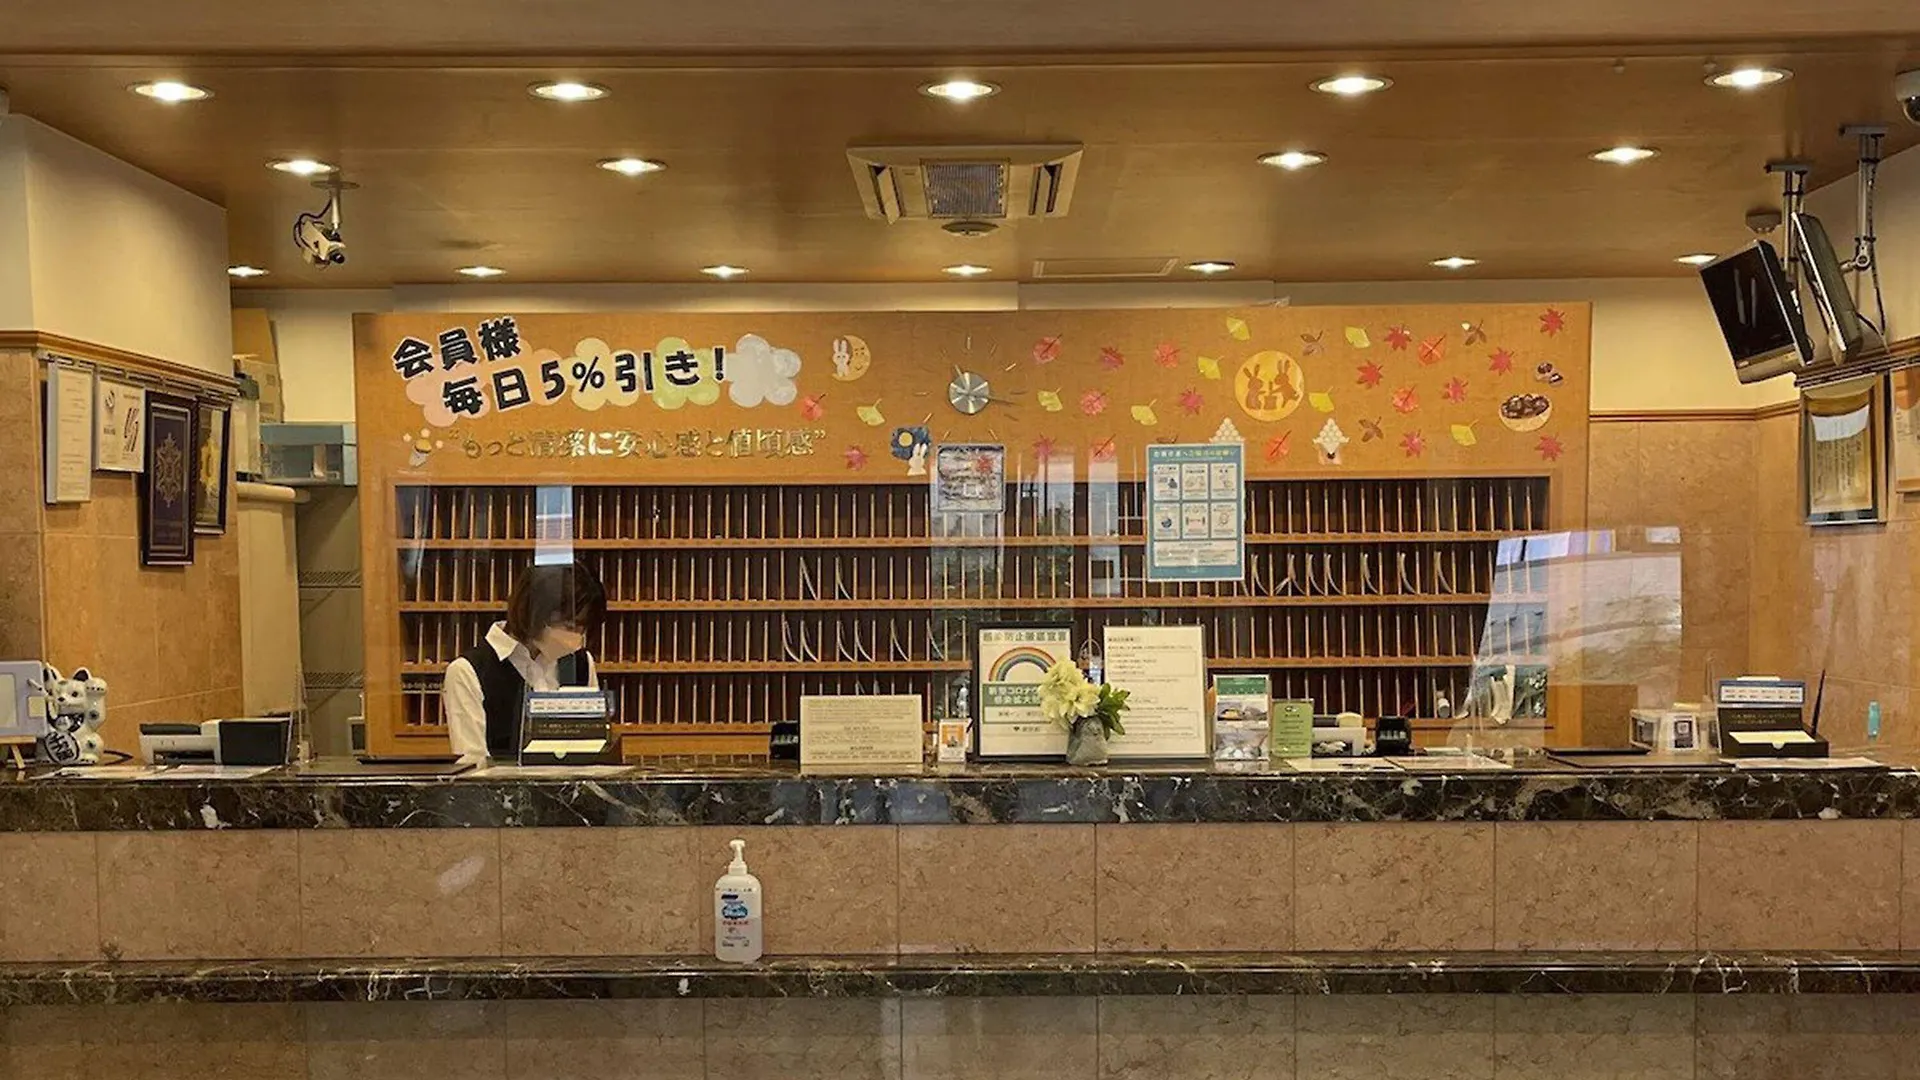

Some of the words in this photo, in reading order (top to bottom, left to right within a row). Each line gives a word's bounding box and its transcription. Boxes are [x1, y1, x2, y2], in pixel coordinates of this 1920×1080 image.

[392, 317, 522, 380] 会員様
[442, 347, 725, 415] 毎日5%引き!
